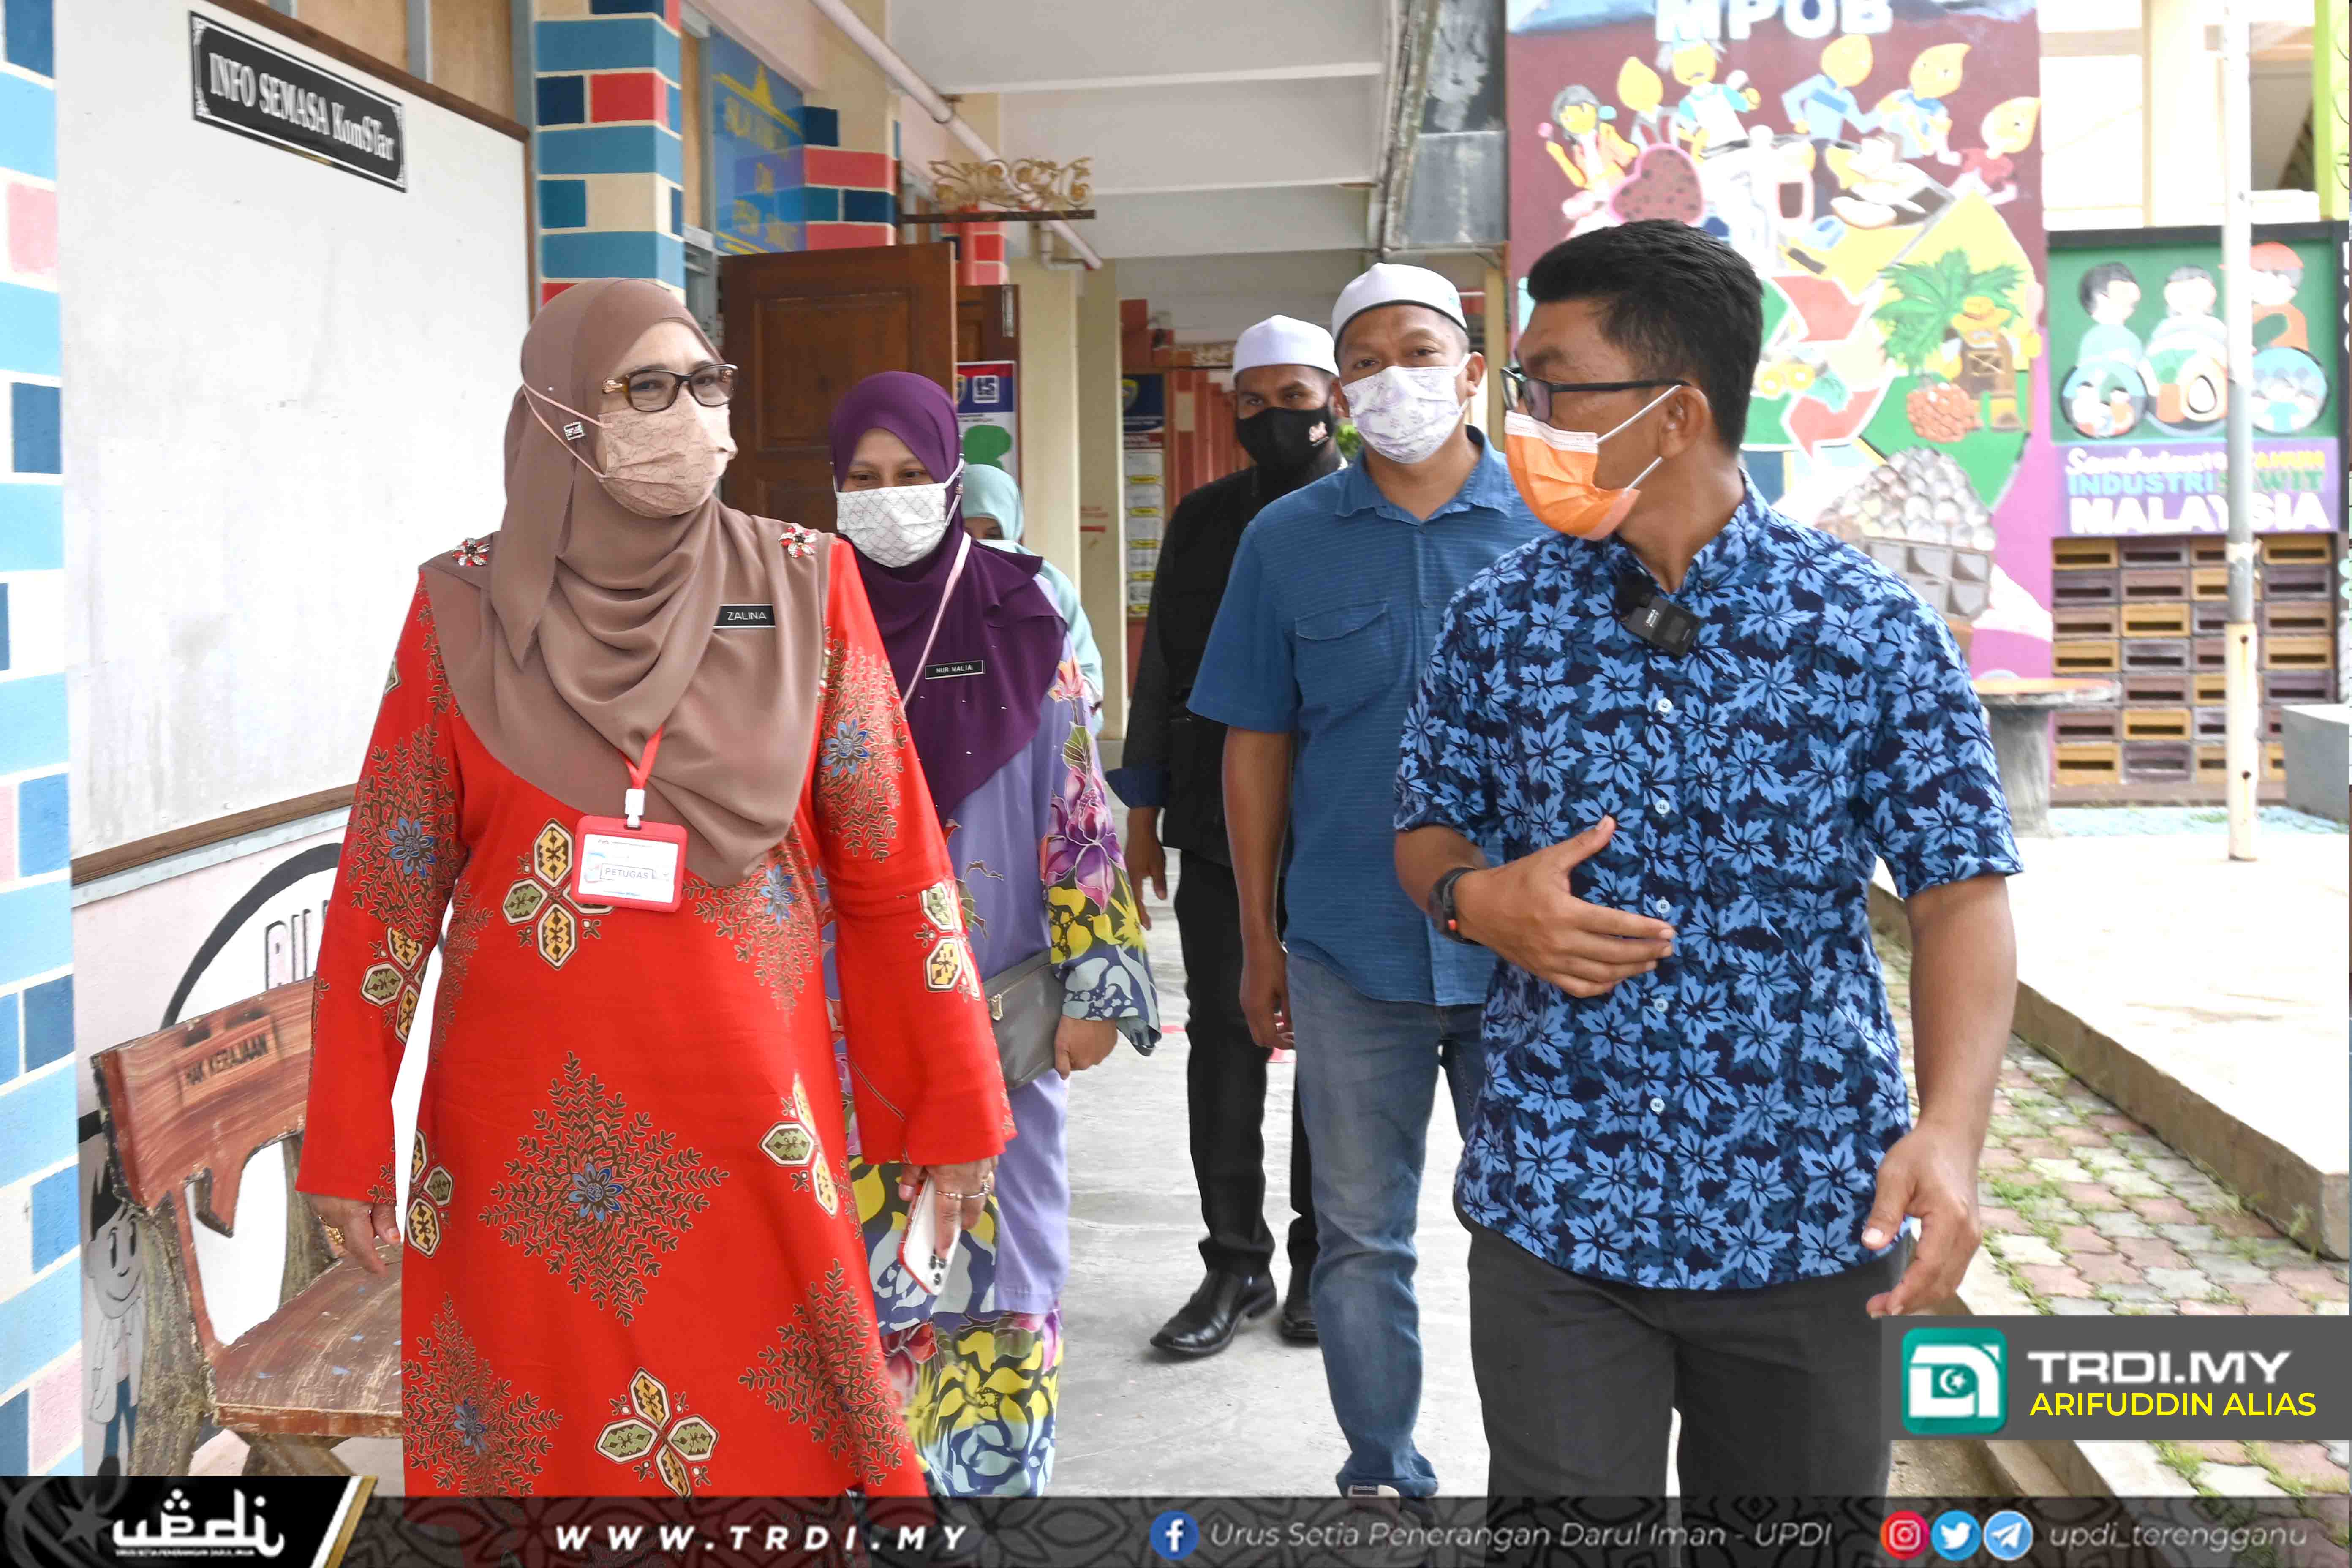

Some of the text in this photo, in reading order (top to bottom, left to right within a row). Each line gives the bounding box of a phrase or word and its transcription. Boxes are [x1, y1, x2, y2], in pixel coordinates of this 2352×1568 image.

[1655, 0, 1894, 41] MPOB
[209, 52, 395, 160] INFO SEMASA KomSTar
[2068, 471, 2216, 496] INDUSTRI
[726, 611, 767, 621] ZALINA
[605, 868, 649, 879] PETUGAS
